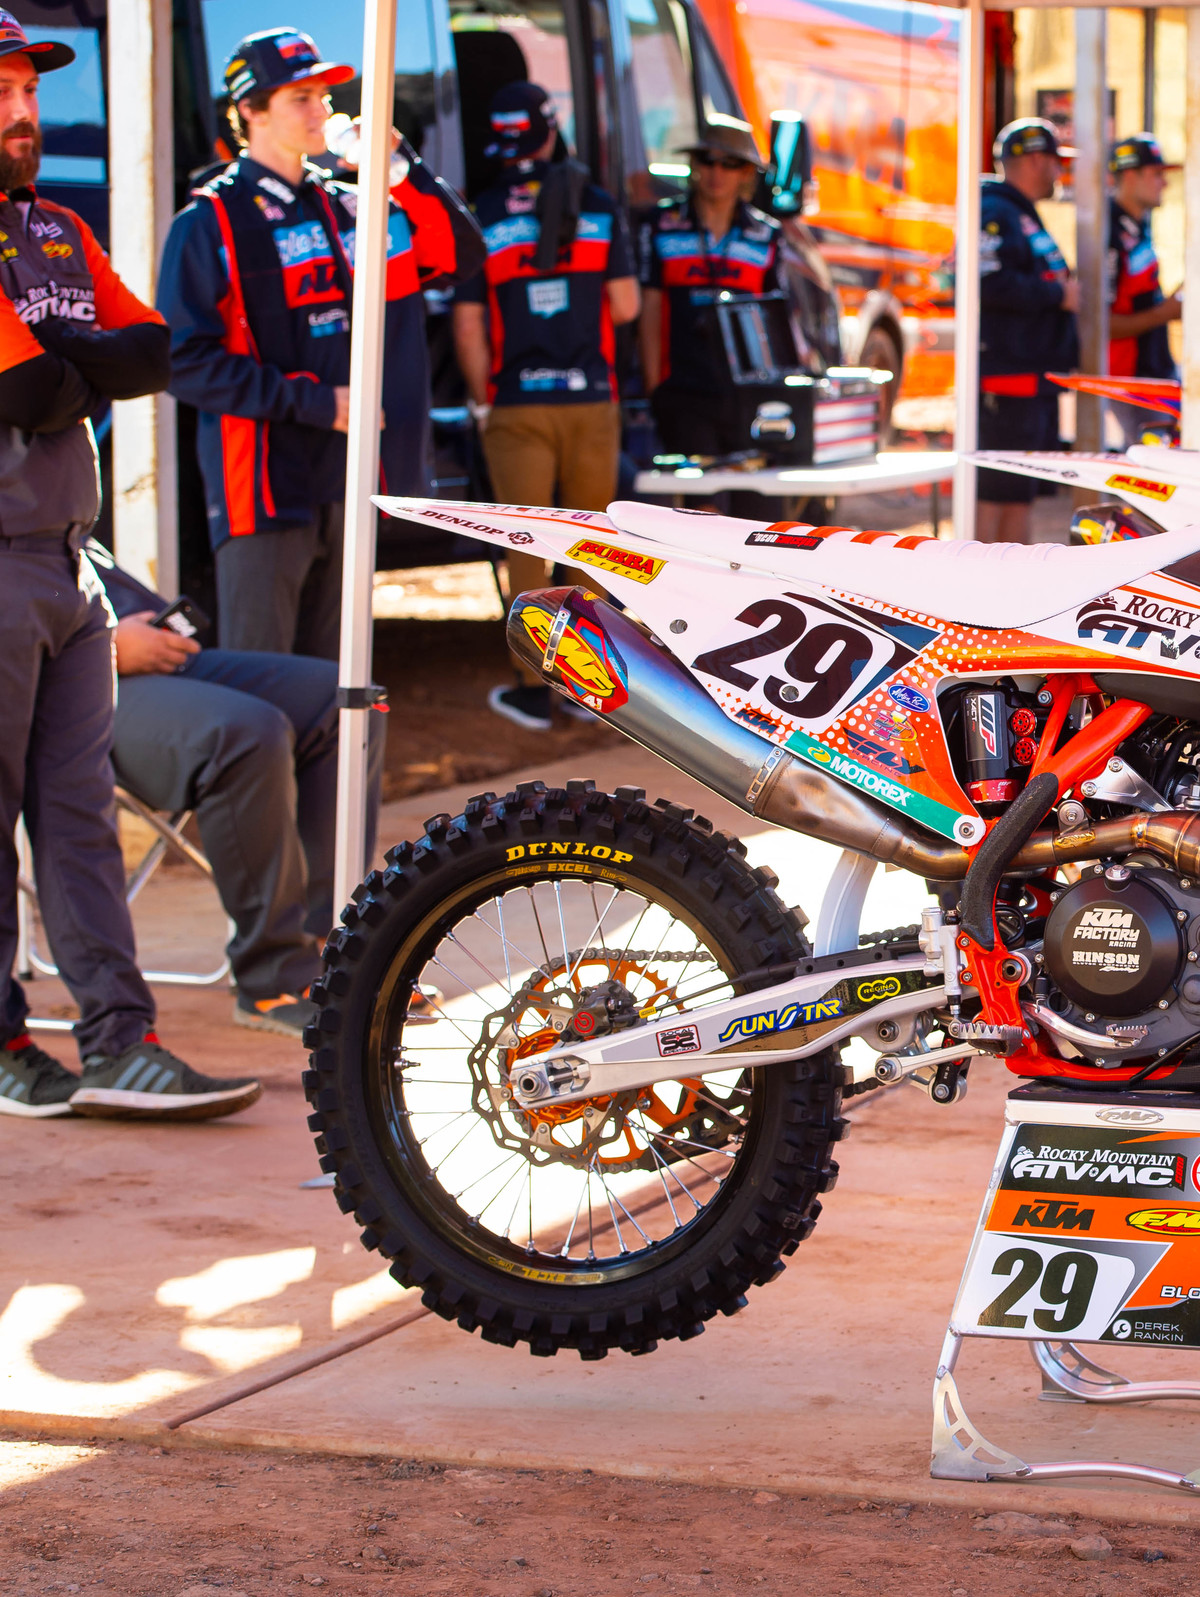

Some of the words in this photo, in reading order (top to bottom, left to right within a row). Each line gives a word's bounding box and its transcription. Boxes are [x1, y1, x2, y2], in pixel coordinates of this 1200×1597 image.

[418, 510, 504, 536] DUNLOP
[574, 551, 645, 580] burger
[577, 541, 657, 576] BUBBA
[520, 610, 617, 691] FMF
[690, 599, 873, 719] 29
[735, 708, 779, 735] KTM
[829, 755, 911, 807] MOTOREX
[505, 842, 634, 864] DUNLOP
[547, 863, 593, 874] EXCEL
[1080, 908, 1133, 928] KTM
[1073, 926, 1140, 942] FACTORY
[1072, 951, 1140, 965] HINSON
[863, 982, 895, 994] REGINA
[1036, 1145, 1090, 1162] ROCKY
[1090, 1149, 1176, 1167] MOUNTAIN
[1011, 1199, 1095, 1231] KTM
[977, 1247, 1099, 1333] 29
[1133, 1331, 1184, 1343] RANKIN
[1134, 1321, 1180, 1332] DEREK
